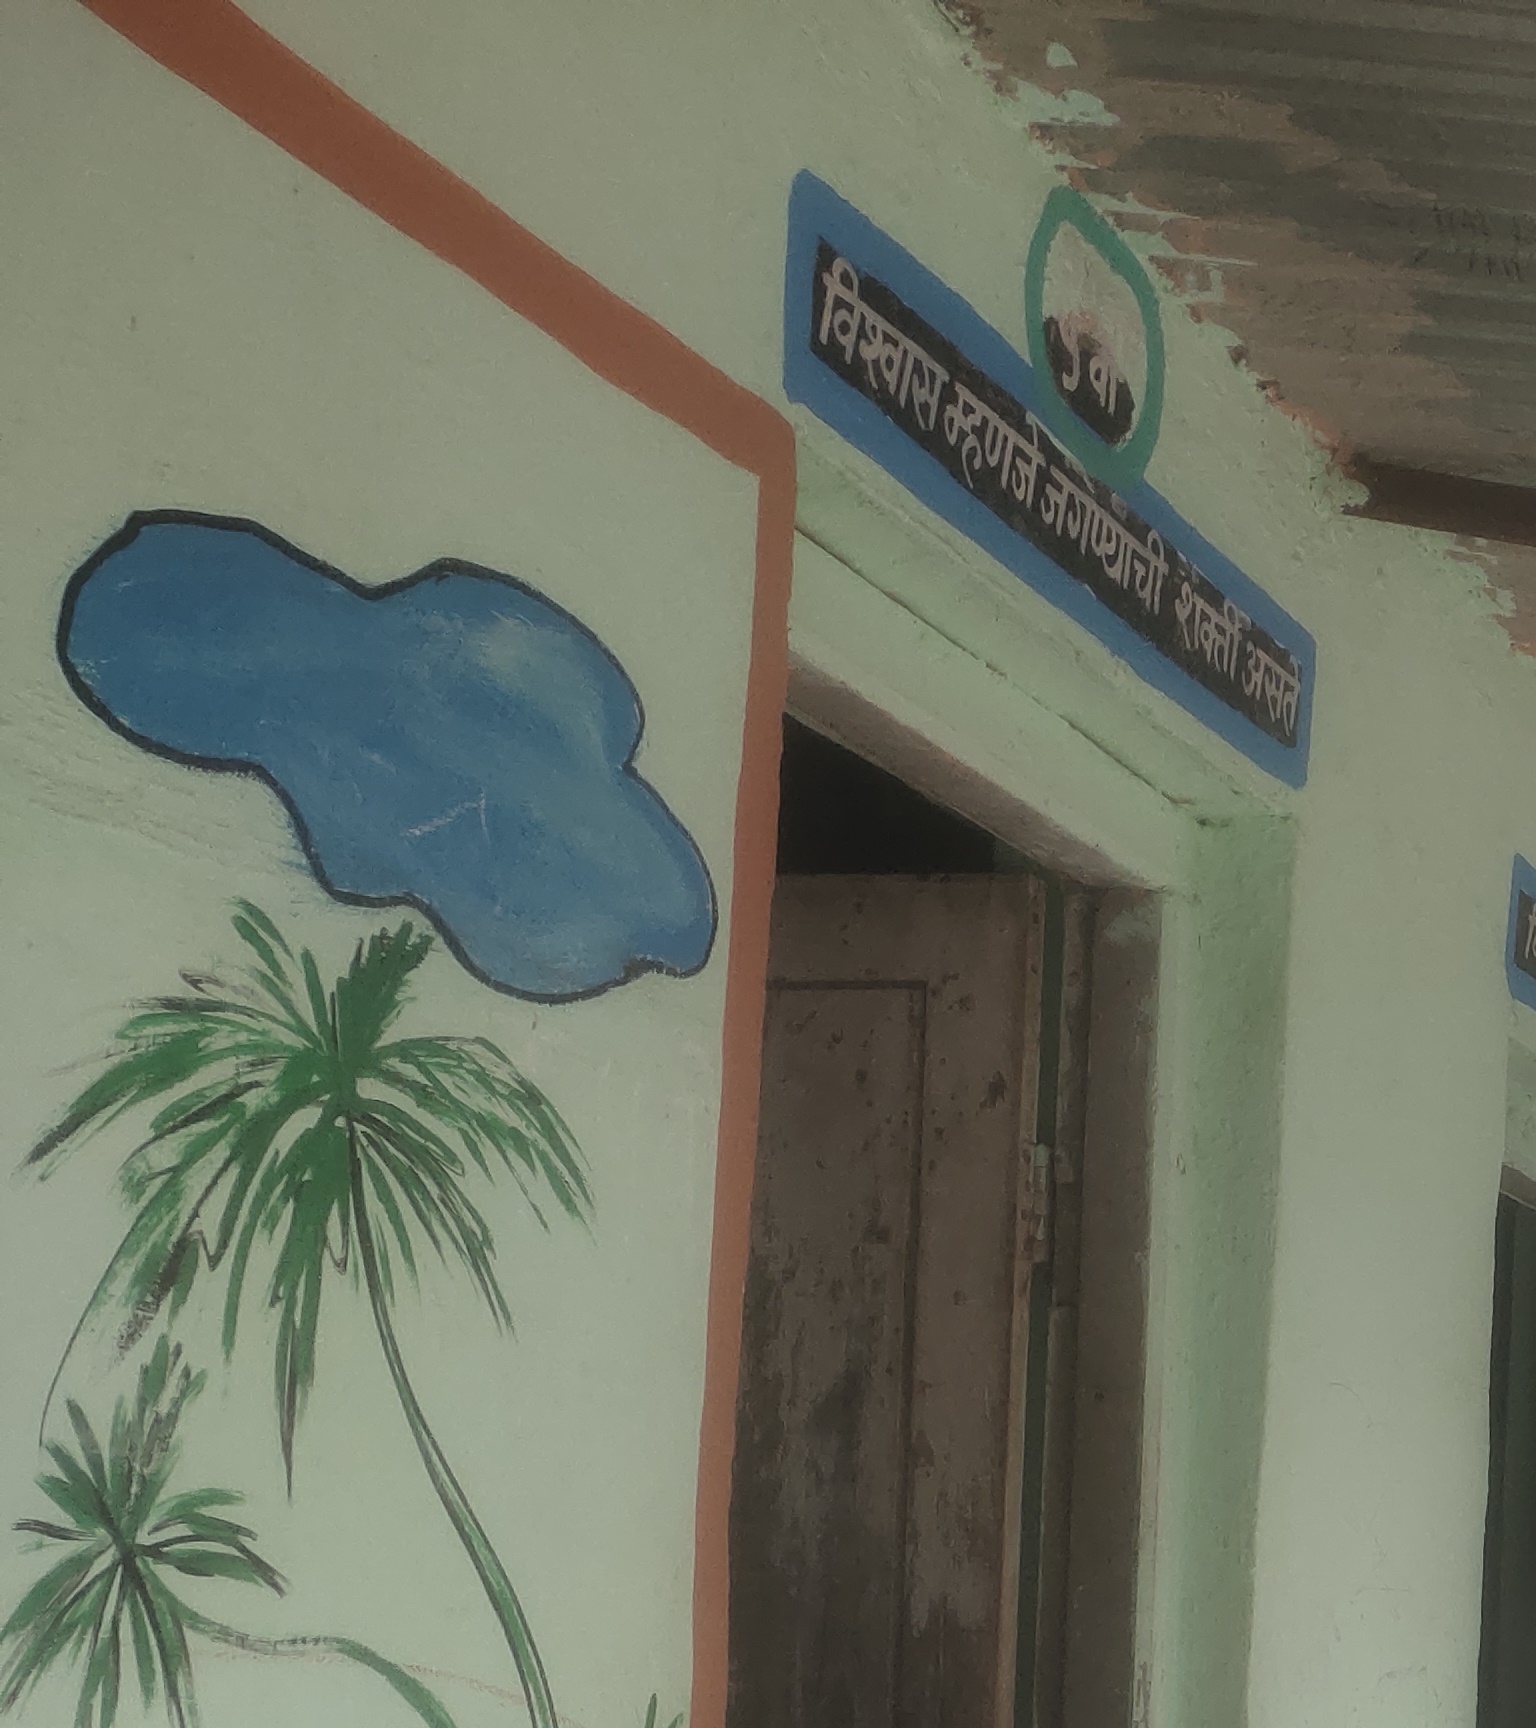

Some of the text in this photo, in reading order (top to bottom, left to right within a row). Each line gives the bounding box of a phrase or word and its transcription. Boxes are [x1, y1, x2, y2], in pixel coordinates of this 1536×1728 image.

[820, 257, 948, 431] विश्वास
[943, 381, 1046, 510] म्हणजे
[1040, 465, 1169, 616] जगण्याची
[1174, 581, 1243, 682] शक्ती
